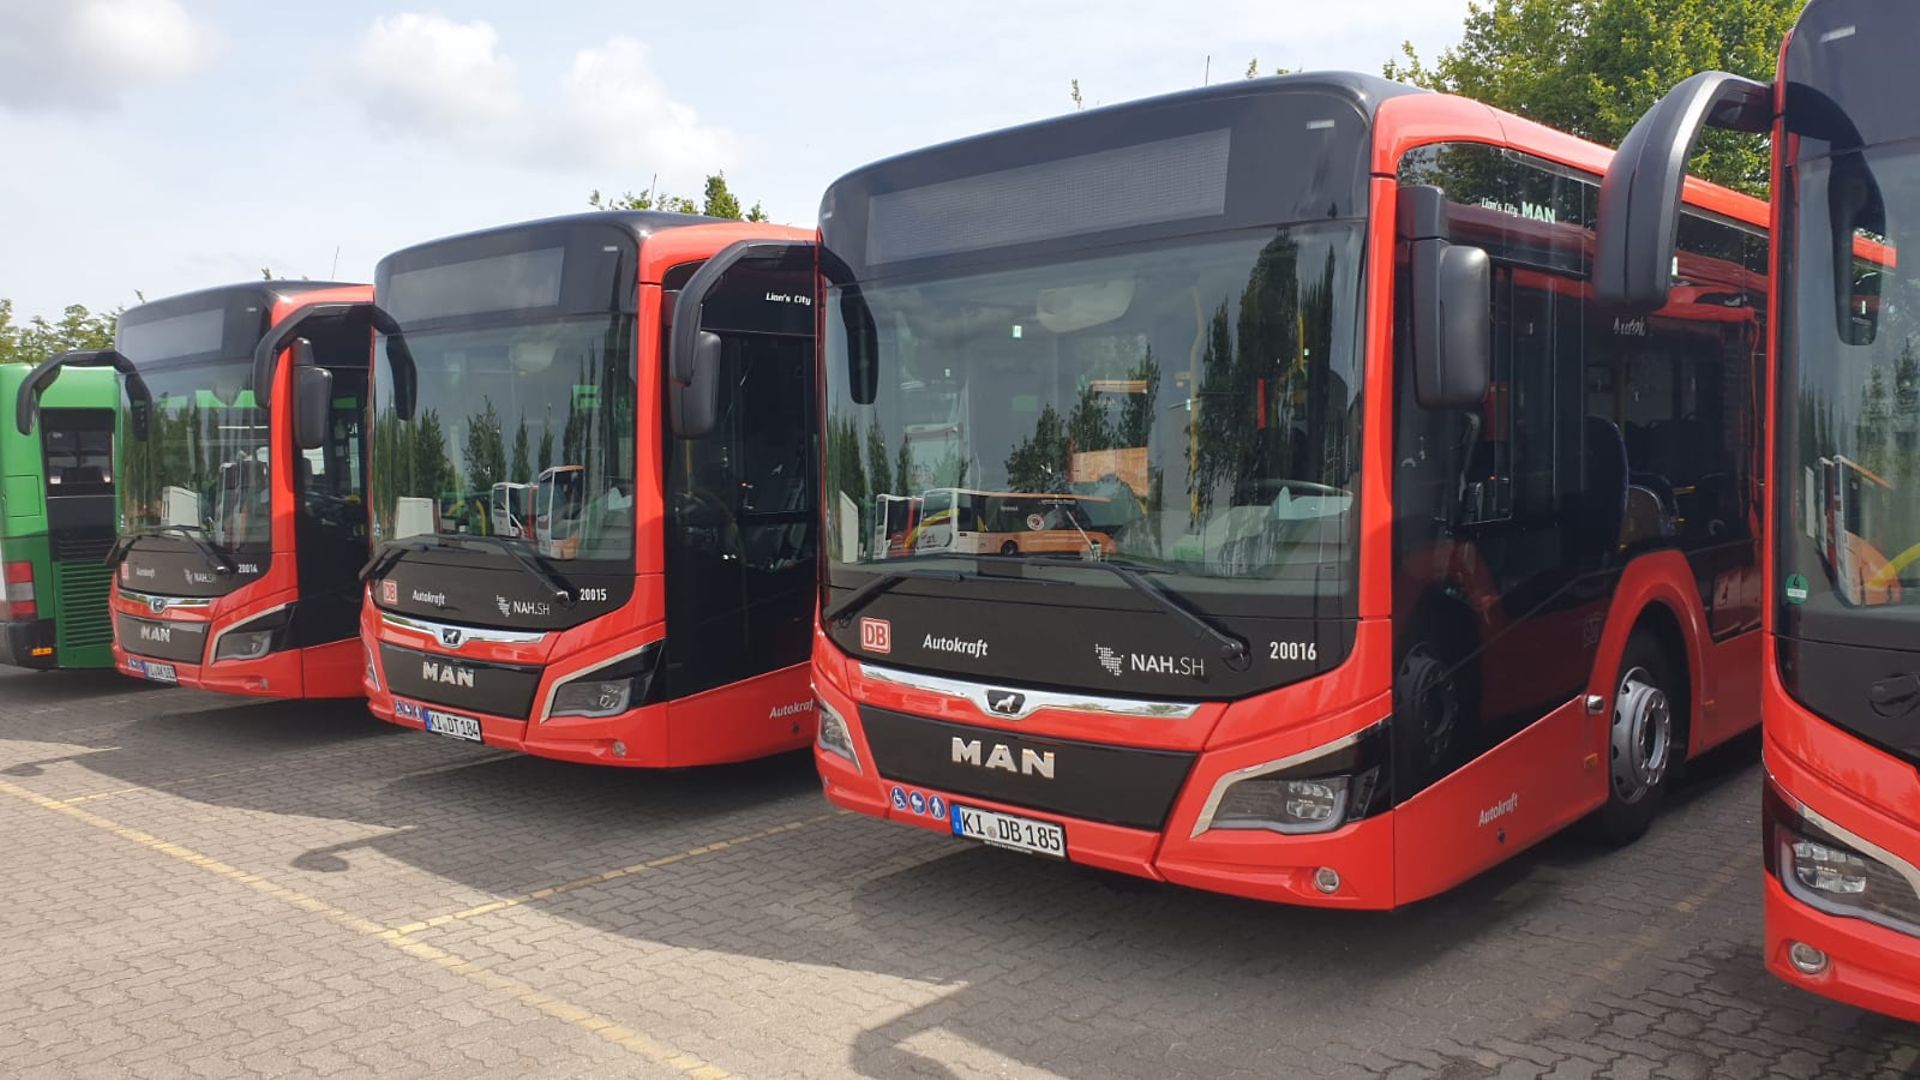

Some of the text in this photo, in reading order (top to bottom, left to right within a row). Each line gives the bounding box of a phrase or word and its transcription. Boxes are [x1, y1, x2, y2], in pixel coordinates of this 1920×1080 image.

[1504, 202, 1519, 218] City
[1522, 201, 1556, 224] MAN
[765, 291, 811, 306] Lion's City
[238, 563, 258, 574] 20014
[384, 581, 397, 603] DB
[412, 588, 446, 607] Autokraft
[580, 588, 608, 602] 20015
[513, 600, 550, 616] NAH.SH
[141, 627, 170, 643] MAN
[863, 621, 888, 649] DB
[922, 633, 988, 659] Autokraft
[1270, 641, 1317, 661] 20016
[423, 661, 474, 688] MAN
[1131, 653, 1204, 676] NAH.SH
[447, 717, 459, 733] DT
[461, 720, 478, 737] 184
[952, 736, 1054, 778] MAN
[1479, 792, 1518, 827] Autokraft
[961, 811, 985, 836] KI
[997, 818, 1022, 843] DB
[1026, 824, 1061, 851] 185
